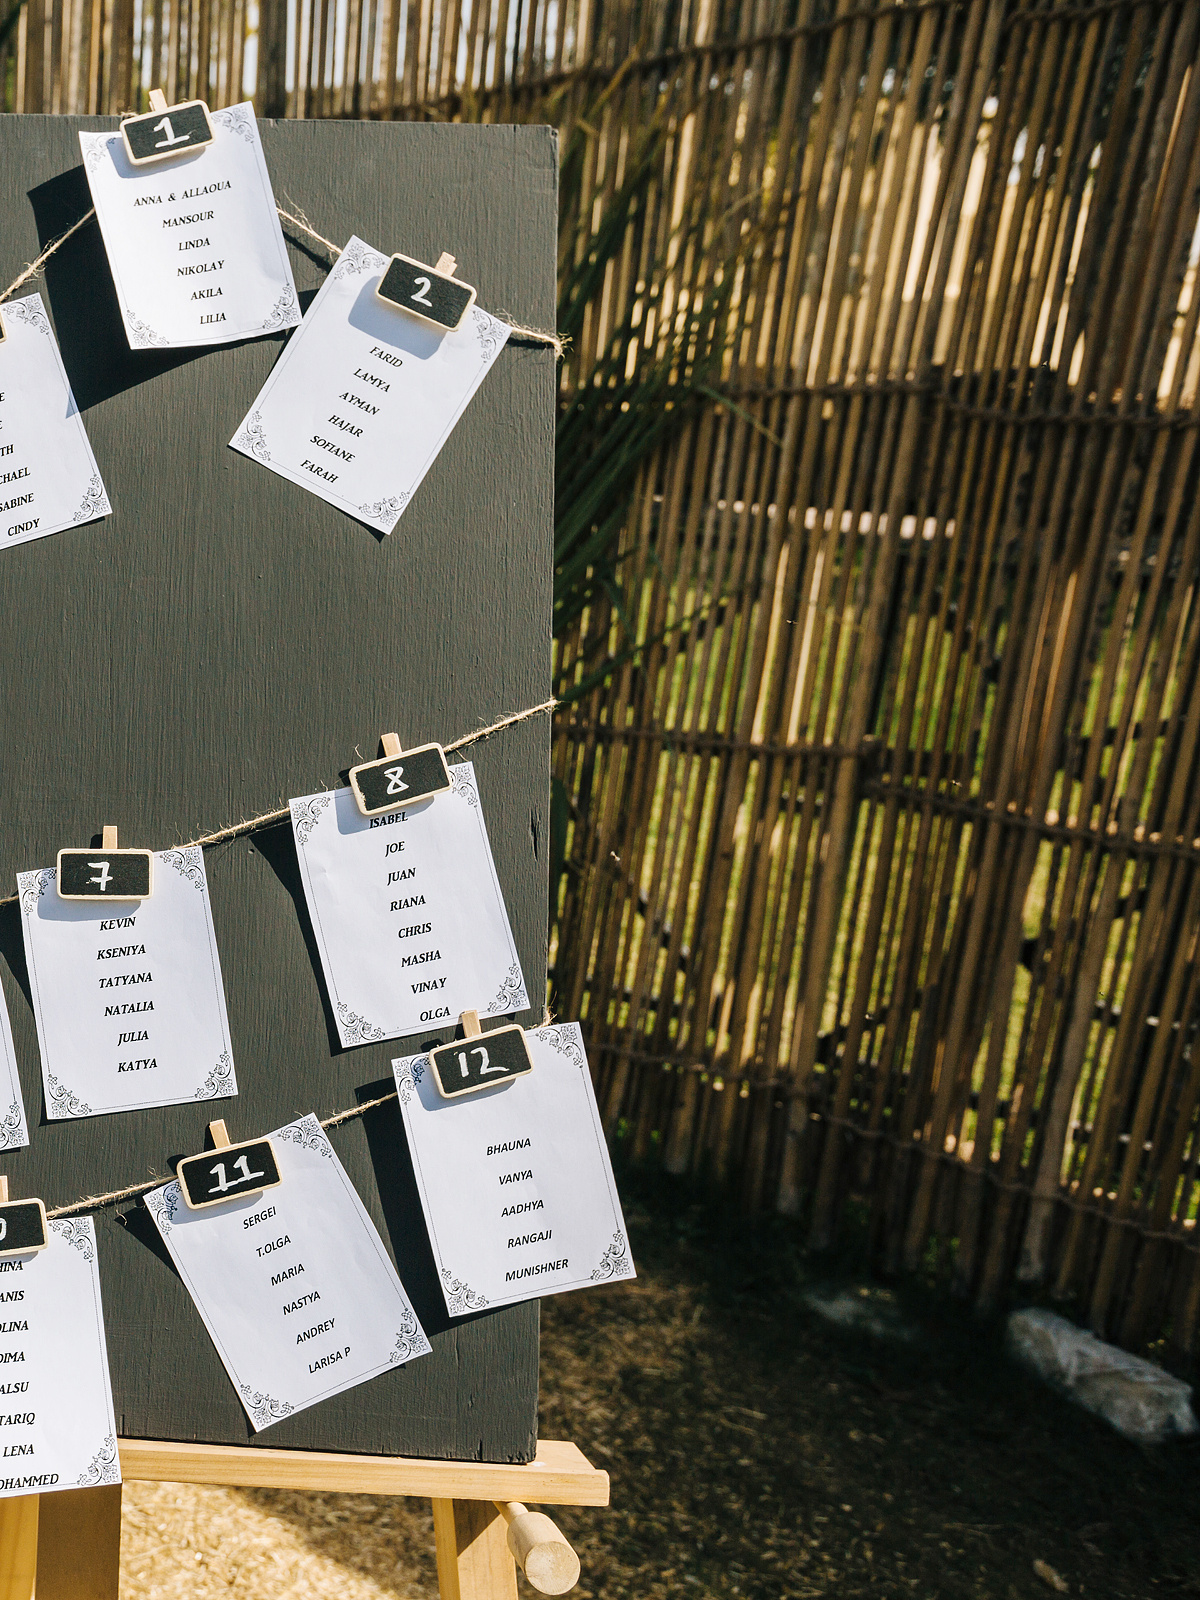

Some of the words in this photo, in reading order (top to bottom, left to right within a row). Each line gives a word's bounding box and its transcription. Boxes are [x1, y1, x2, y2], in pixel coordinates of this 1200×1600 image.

[153, 116, 190, 148] 1
[133, 194, 163, 207] ANNA
[167, 192, 176, 201] &
[181, 180, 232, 200] ALLAOUA
[162, 210, 215, 228] MANSOUR
[178, 237, 211, 251] LINDA
[176, 260, 225, 277] NIKOLAY
[190, 287, 224, 301] AKILA
[410, 276, 433, 307] 2
[199, 312, 227, 325] LILIA
[369, 346, 403, 368] FARID
[353, 368, 390, 393] LAMYA
[338, 391, 380, 416] AYMAN
[327, 415, 364, 438] HAJAR
[309, 435, 356, 463] SOFIANE
[300, 459, 339, 483] FARAH
[7, 518, 40, 537] CINDY
[383, 766, 410, 795] 8
[369, 811, 409, 829] ISABEL
[385, 840, 405, 858] JOE
[85, 861, 114, 892] 7
[387, 867, 417, 886] JUAN
[389, 894, 426, 912] RIANA
[100, 916, 136, 931] KEVIN
[397, 922, 432, 939] CHRIS
[96, 944, 146, 960] KSENIYA
[401, 950, 442, 968] MASHA
[98, 972, 153, 989] TATYANA
[410, 977, 447, 995] VINAY
[104, 1000, 155, 1017] NATALIA
[419, 1007, 451, 1022] OLGA
[117, 1030, 149, 1046] JULIA
[117, 1058, 158, 1073] KATYA
[453, 1046, 510, 1078] 12
[486, 1137, 532, 1156] BHAUNA
[207, 1154, 265, 1194] 11
[498, 1169, 533, 1186] VANYA
[242, 1206, 277, 1230] SERGEI
[500, 1199, 545, 1218] AADHYA
[255, 1234, 292, 1258] T.OLGA
[507, 1229, 553, 1249] RANGAJI
[270, 1263, 305, 1286] MARIA
[505, 1258, 569, 1282] MUNISHNER
[282, 1290, 321, 1316] NASTYA
[295, 1318, 336, 1345] ANDREY
[308, 1350, 343, 1374] LARISA
[344, 1346, 351, 1357] P
[2, 1444, 35, 1458] LENA
